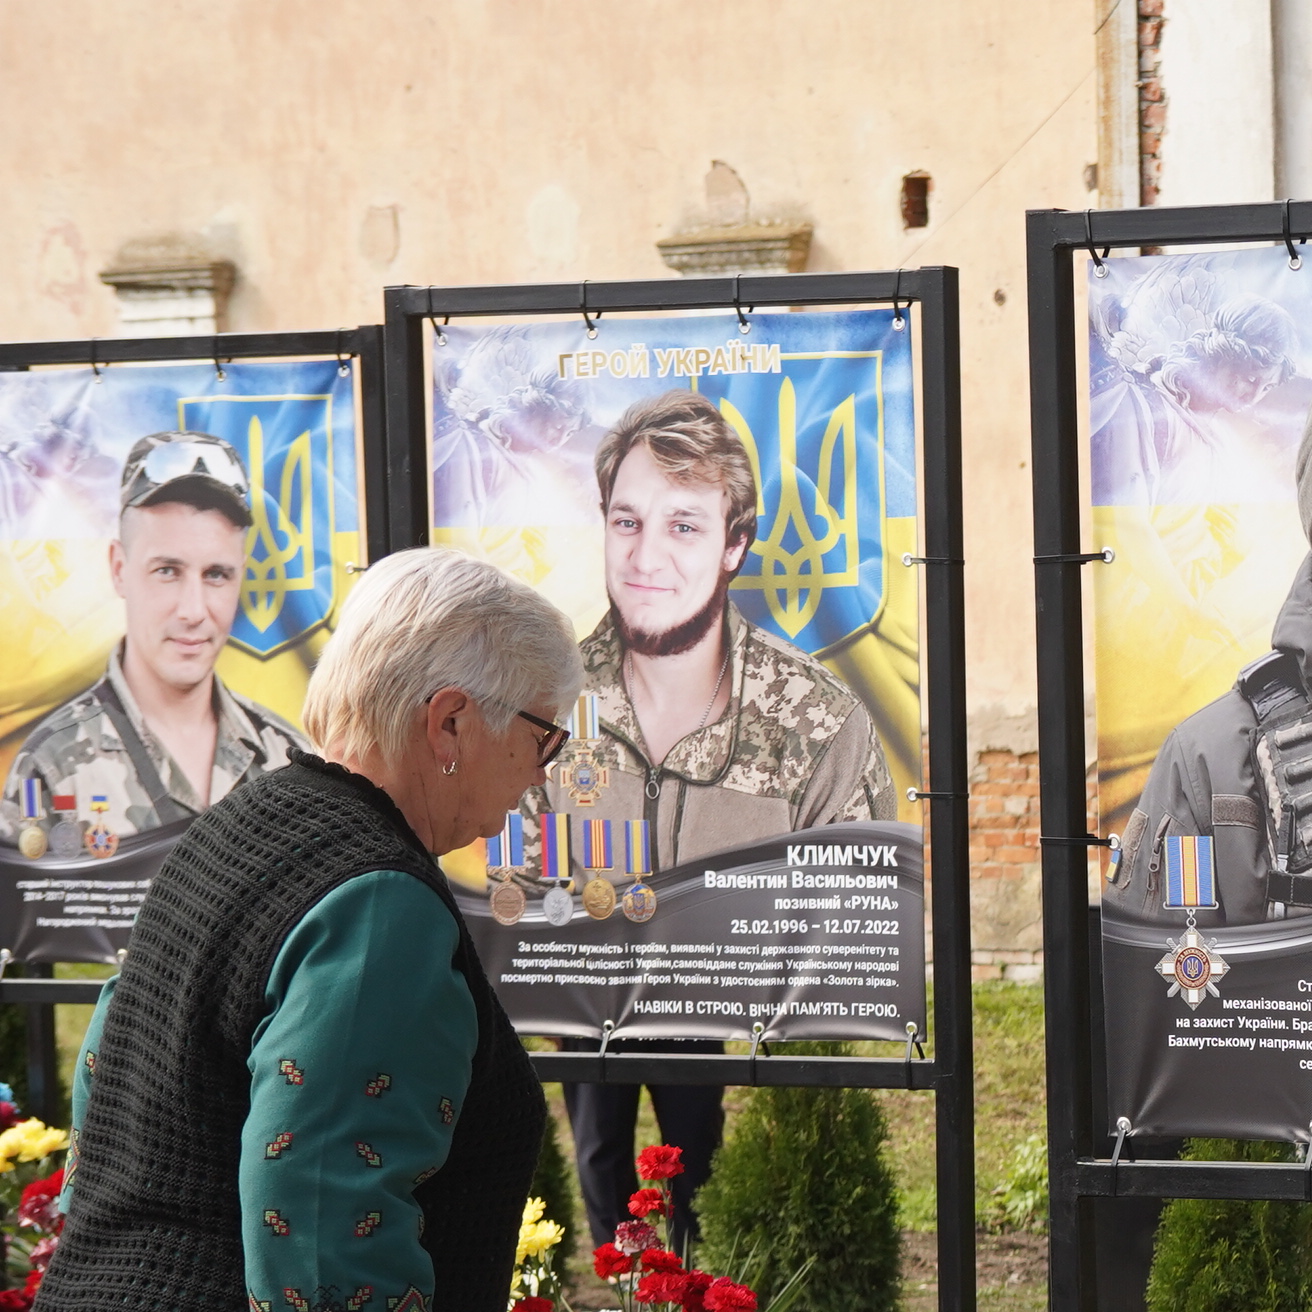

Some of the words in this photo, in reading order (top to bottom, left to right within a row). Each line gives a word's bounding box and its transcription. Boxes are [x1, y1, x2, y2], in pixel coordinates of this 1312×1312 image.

[557, 343, 650, 380] ГЕРОЙ
[653, 339, 782, 378] УКРАЇНИ
[787, 845, 898, 867] КЛИМЧУК
[704, 871, 787, 889] Валентин
[791, 871, 898, 889] Васильович
[774, 895, 841, 910] позивний
[843, 896, 899, 911] «РУНА»
[730, 919, 808, 935] 25.02.1996
[823, 920, 899, 935] 12.07.2022
[518, 941, 531, 953] За
[532, 942, 578, 955] особисту
[579, 943, 624, 955] мужність
[670, 943, 715, 954] виявлені
[724, 944, 760, 955] захисті
[761, 944, 821, 956] державного
[822, 944, 887, 957] суверенітету
[888, 946, 899, 956] та
[512, 957, 585, 969] територіальної
[738, 959, 784, 972] служіння
[785, 959, 853, 972] Українському
[854, 960, 900, 972] народові
[501, 974, 553, 985] посмертно
[554, 974, 606, 986] присвоєно
[673, 973, 712, 987] України
[720, 975, 786, 987] удостоєнням
[787, 976, 822, 988] ордена
[823, 974, 863, 986] «Золота
[865, 975, 899, 988] зірка».
[634, 1000, 685, 1014] НАВІКИ
[686, 1001, 694, 1014] В
[696, 1001, 747, 1016] СТРОЮ.
[749, 1002, 788, 1018] ВІЧНА
[789, 1001, 849, 1016] ПАМ'ЯТЬ
[851, 1003, 901, 1018] ГЕРОЮ.
[1222, 998, 1312, 1012] механізованої
[1175, 1018, 1191, 1029] на
[1192, 1017, 1235, 1029] захист
[1236, 1016, 1290, 1033] України.
[1168, 1034, 1256, 1050] Бахмутському
